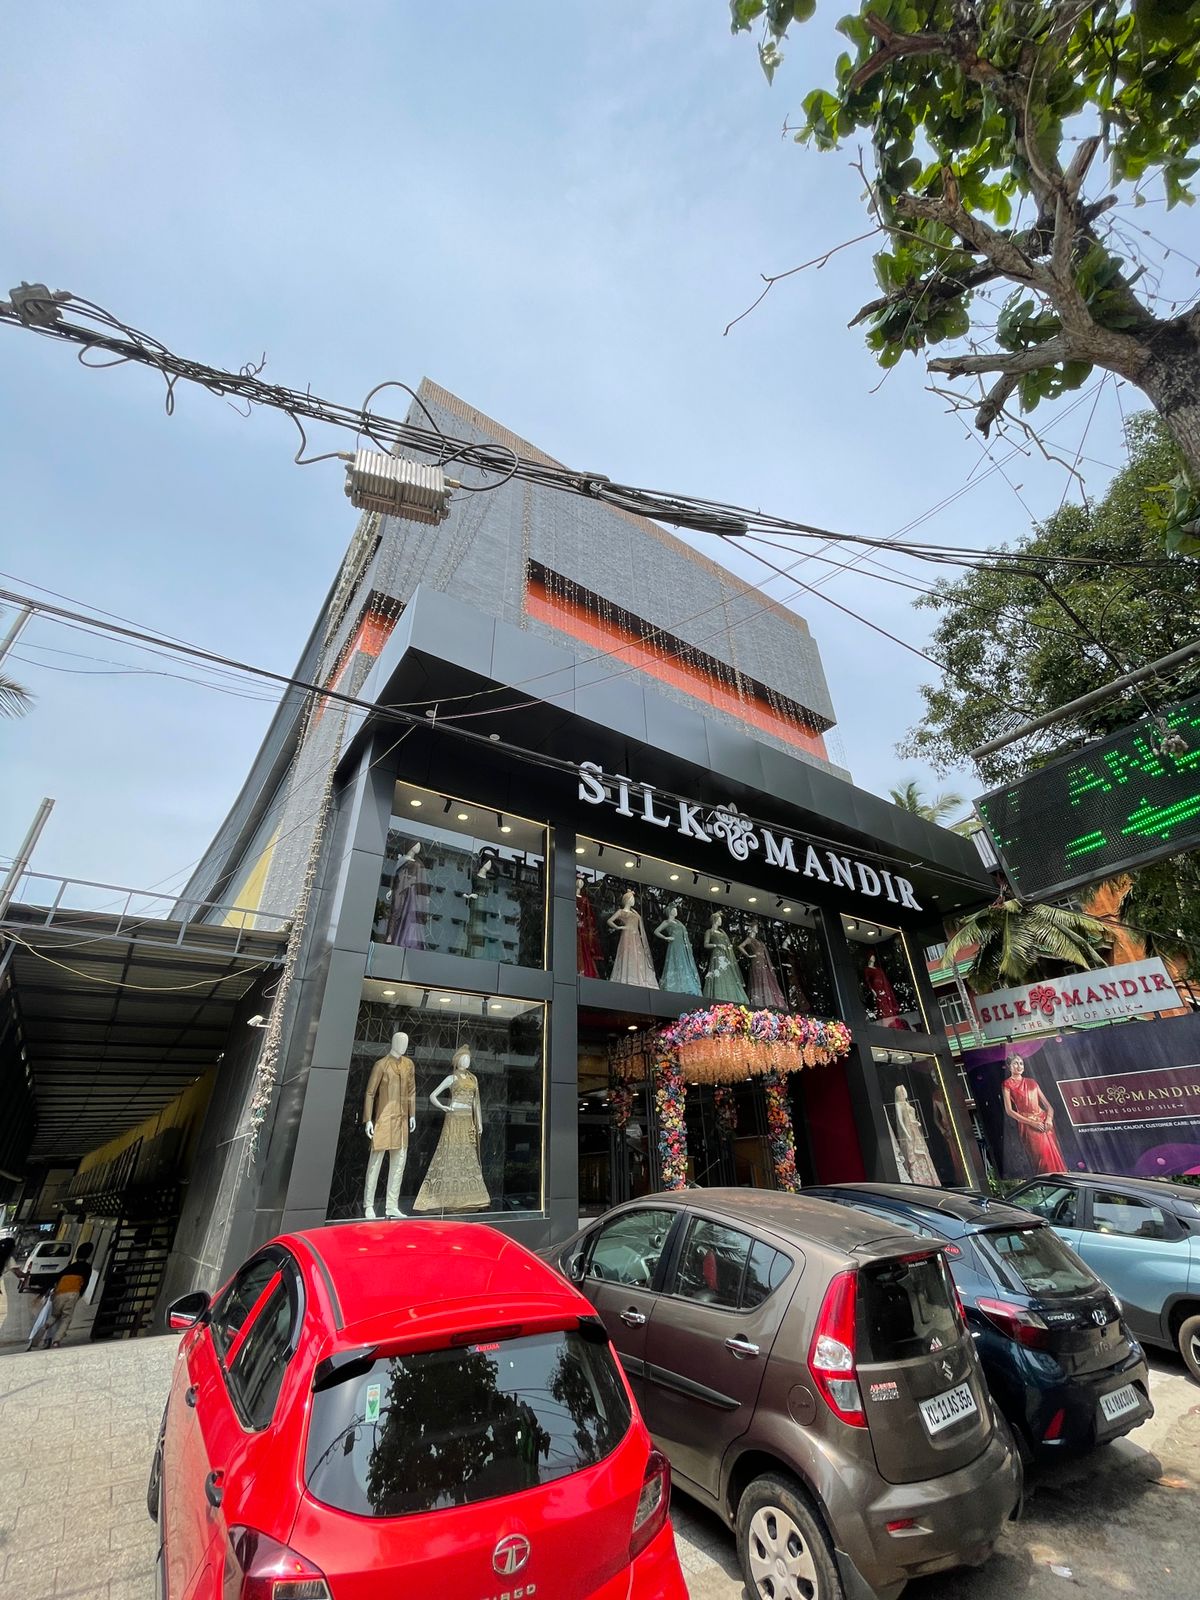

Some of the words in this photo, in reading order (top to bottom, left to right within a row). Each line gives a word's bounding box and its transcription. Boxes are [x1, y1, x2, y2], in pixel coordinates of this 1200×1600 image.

[578, 760, 712, 843] SILK
[760, 828, 923, 912] MANDIR
[980, 1000, 1033, 1024] SILK
[1061, 973, 1173, 1008] MANDIR
[1022, 1020, 1043, 1030] THE
[1084, 1010, 1098, 1020] OF
[1104, 1004, 1135, 1016] SILK
[1071, 1093, 1109, 1108] SILK
[1130, 1083, 1200, 1102] MANDIR
[1123, 1106, 1142, 1114] SOUL
